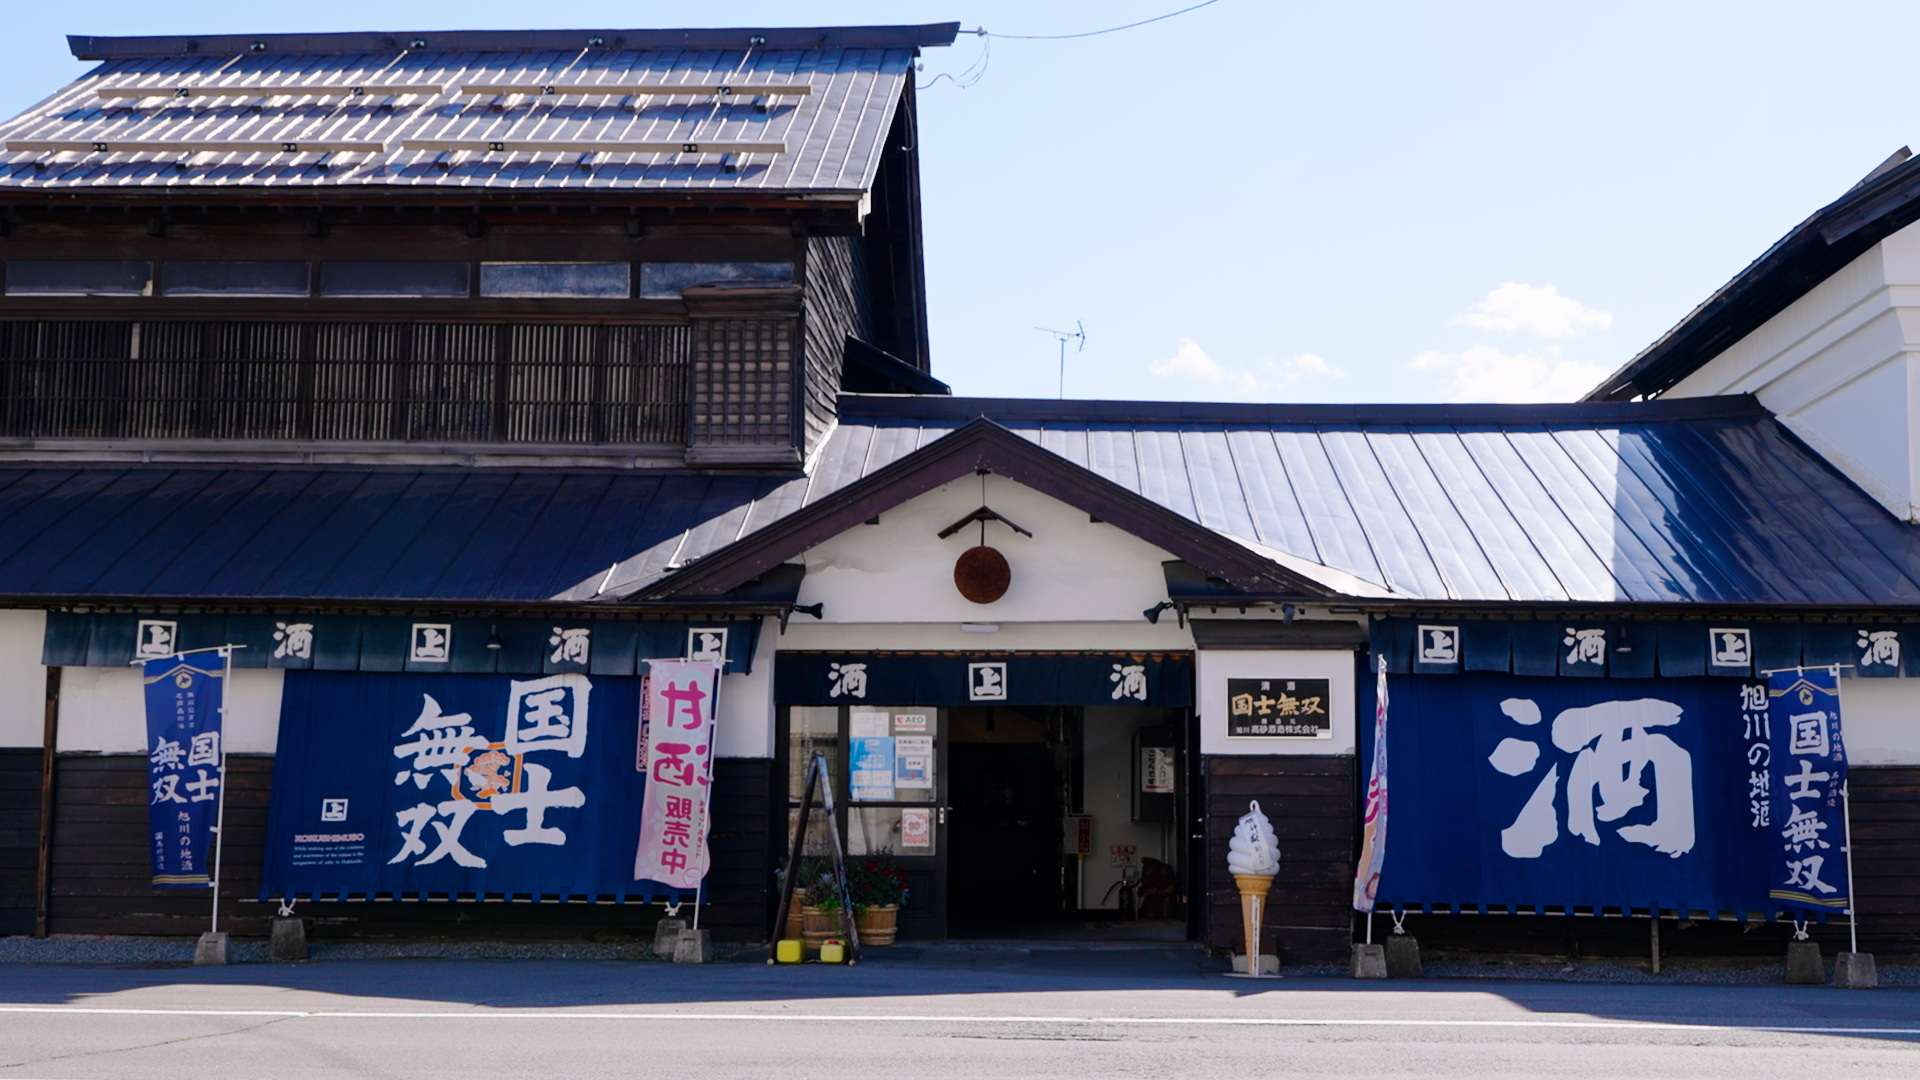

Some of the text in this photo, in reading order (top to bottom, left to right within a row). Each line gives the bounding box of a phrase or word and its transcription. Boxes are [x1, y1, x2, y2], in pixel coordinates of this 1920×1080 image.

[273, 622, 314, 659] 酒
[549, 627, 590, 664] 酒
[1564, 628, 1606, 665] 酒
[1857, 629, 1900, 667] 酒
[828, 662, 868, 699] 酒
[1110, 664, 1147, 700] 酒
[905, 716, 924, 724] AED
[1232, 692, 1326, 717] 国士無双
[150, 735, 188, 806] 無双
[185, 731, 220, 804] 国士
[490, 674, 593, 847] 国士
[1488, 698, 1696, 859] 酒
[387, 693, 490, 868] 無双
[1782, 711, 1838, 894] 国士無双
